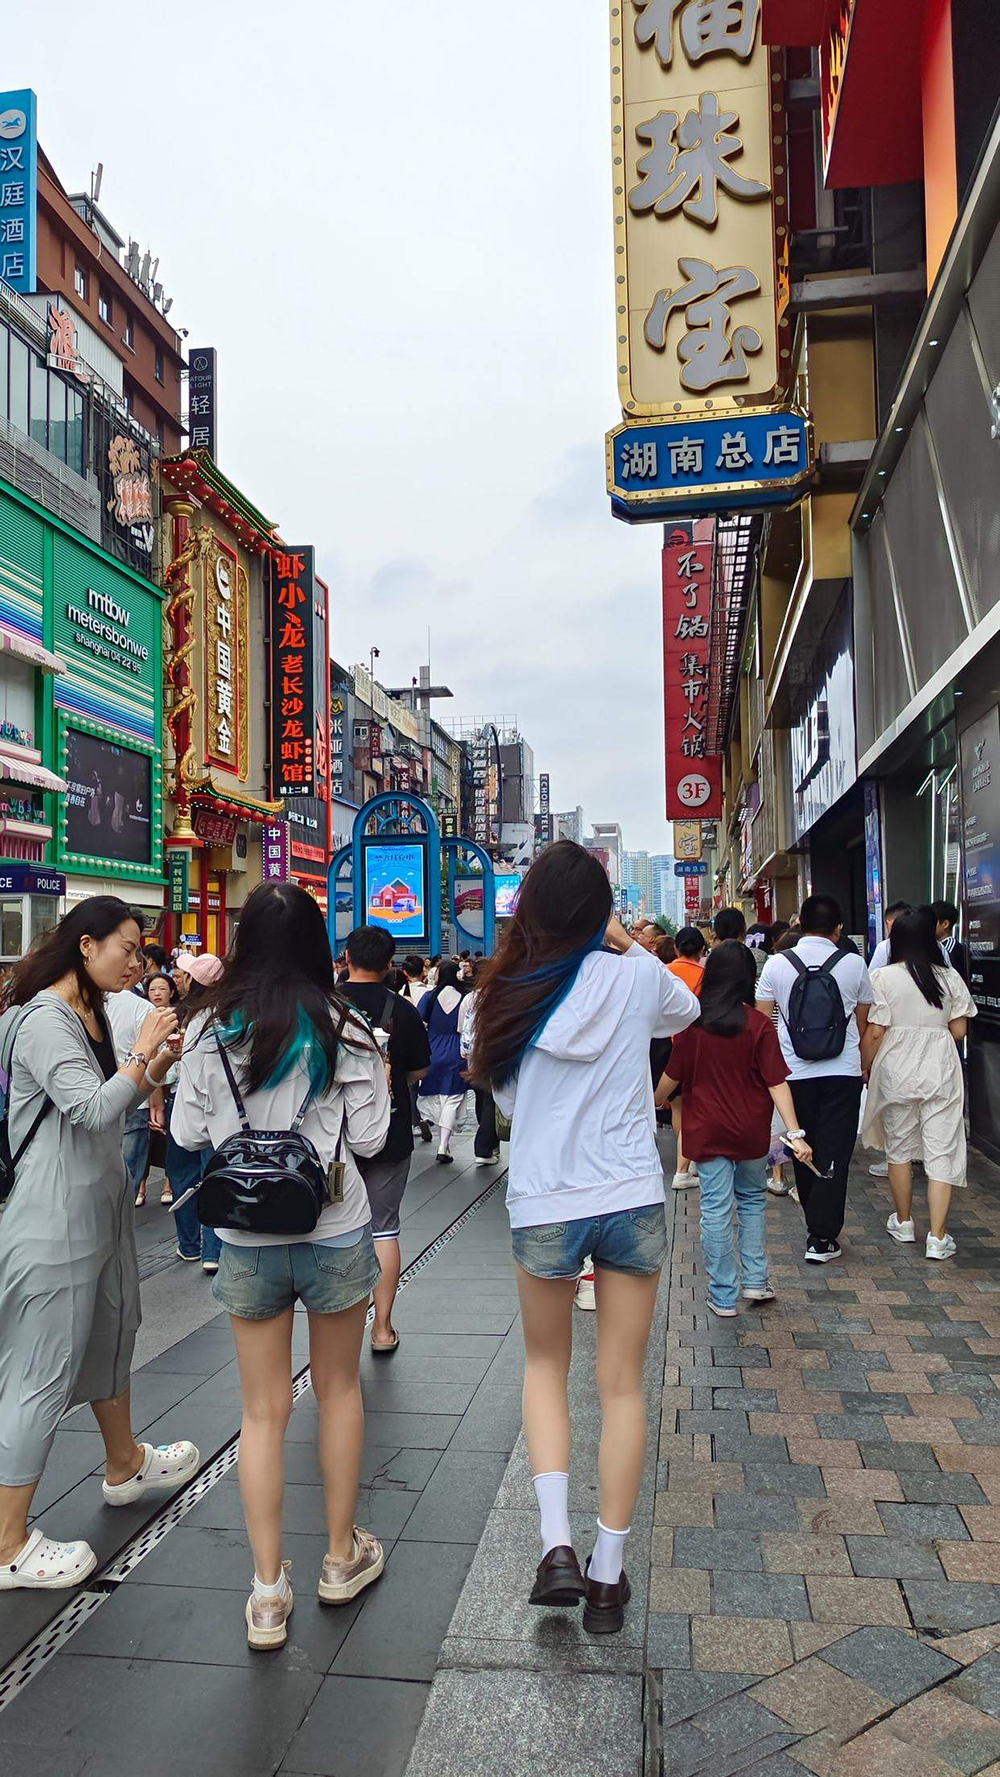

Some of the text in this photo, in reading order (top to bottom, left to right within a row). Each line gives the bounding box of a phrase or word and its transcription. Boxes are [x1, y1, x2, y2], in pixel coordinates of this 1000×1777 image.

[0, 147, 26, 279] 汉庭酒店
[190, 395, 211, 447] 轻居
[621, 425, 800, 480] 湖南总店
[68, 604, 148, 661] metersbonwe
[75, 632, 110, 658] shanghai
[216, 602, 233, 755] 中国黄金
[682, 782, 706, 800] 3F
[37, 878, 61, 891] POLICE
